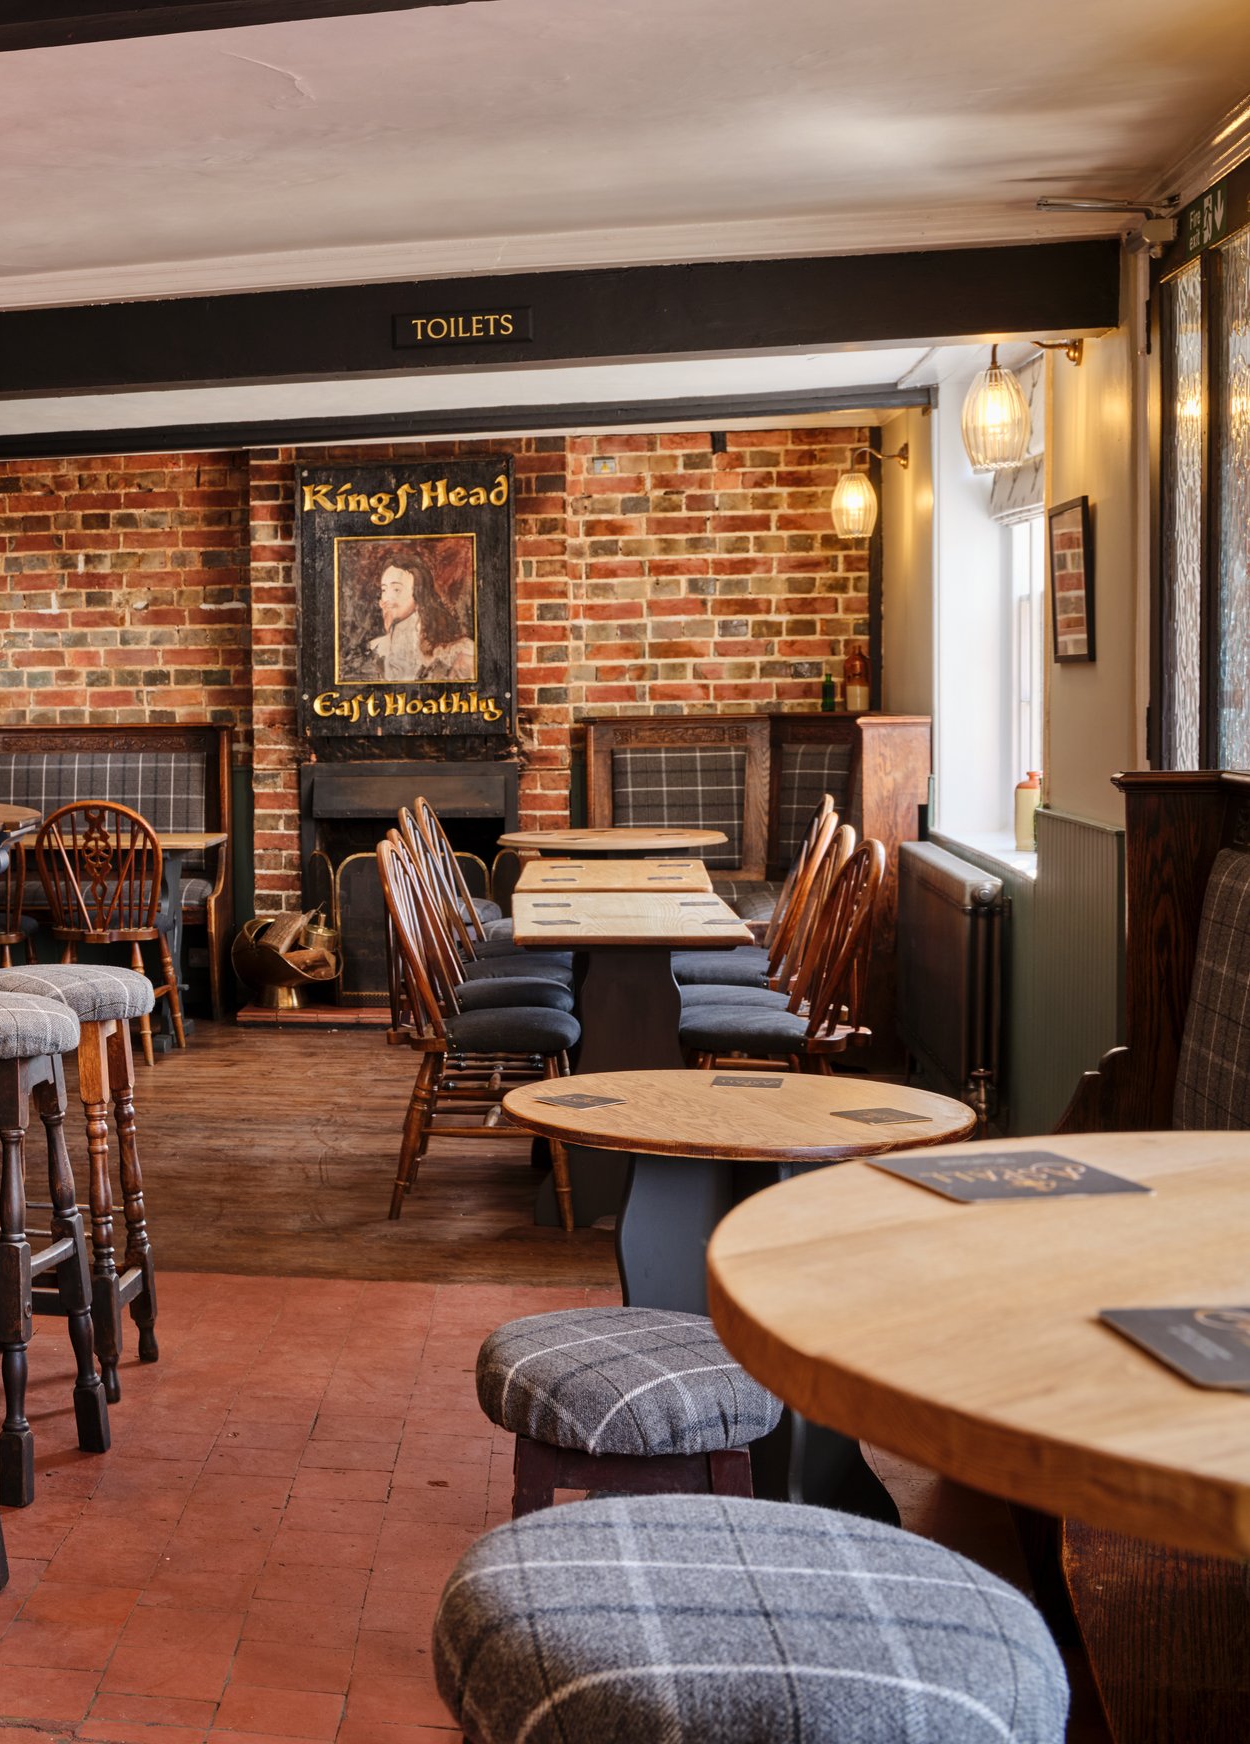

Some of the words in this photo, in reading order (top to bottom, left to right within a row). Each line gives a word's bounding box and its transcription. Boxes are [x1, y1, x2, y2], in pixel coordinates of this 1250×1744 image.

[411, 314, 514, 340] TOILETS
[419, 475, 509, 512] Head
[384, 690, 503, 722] Hoathly
